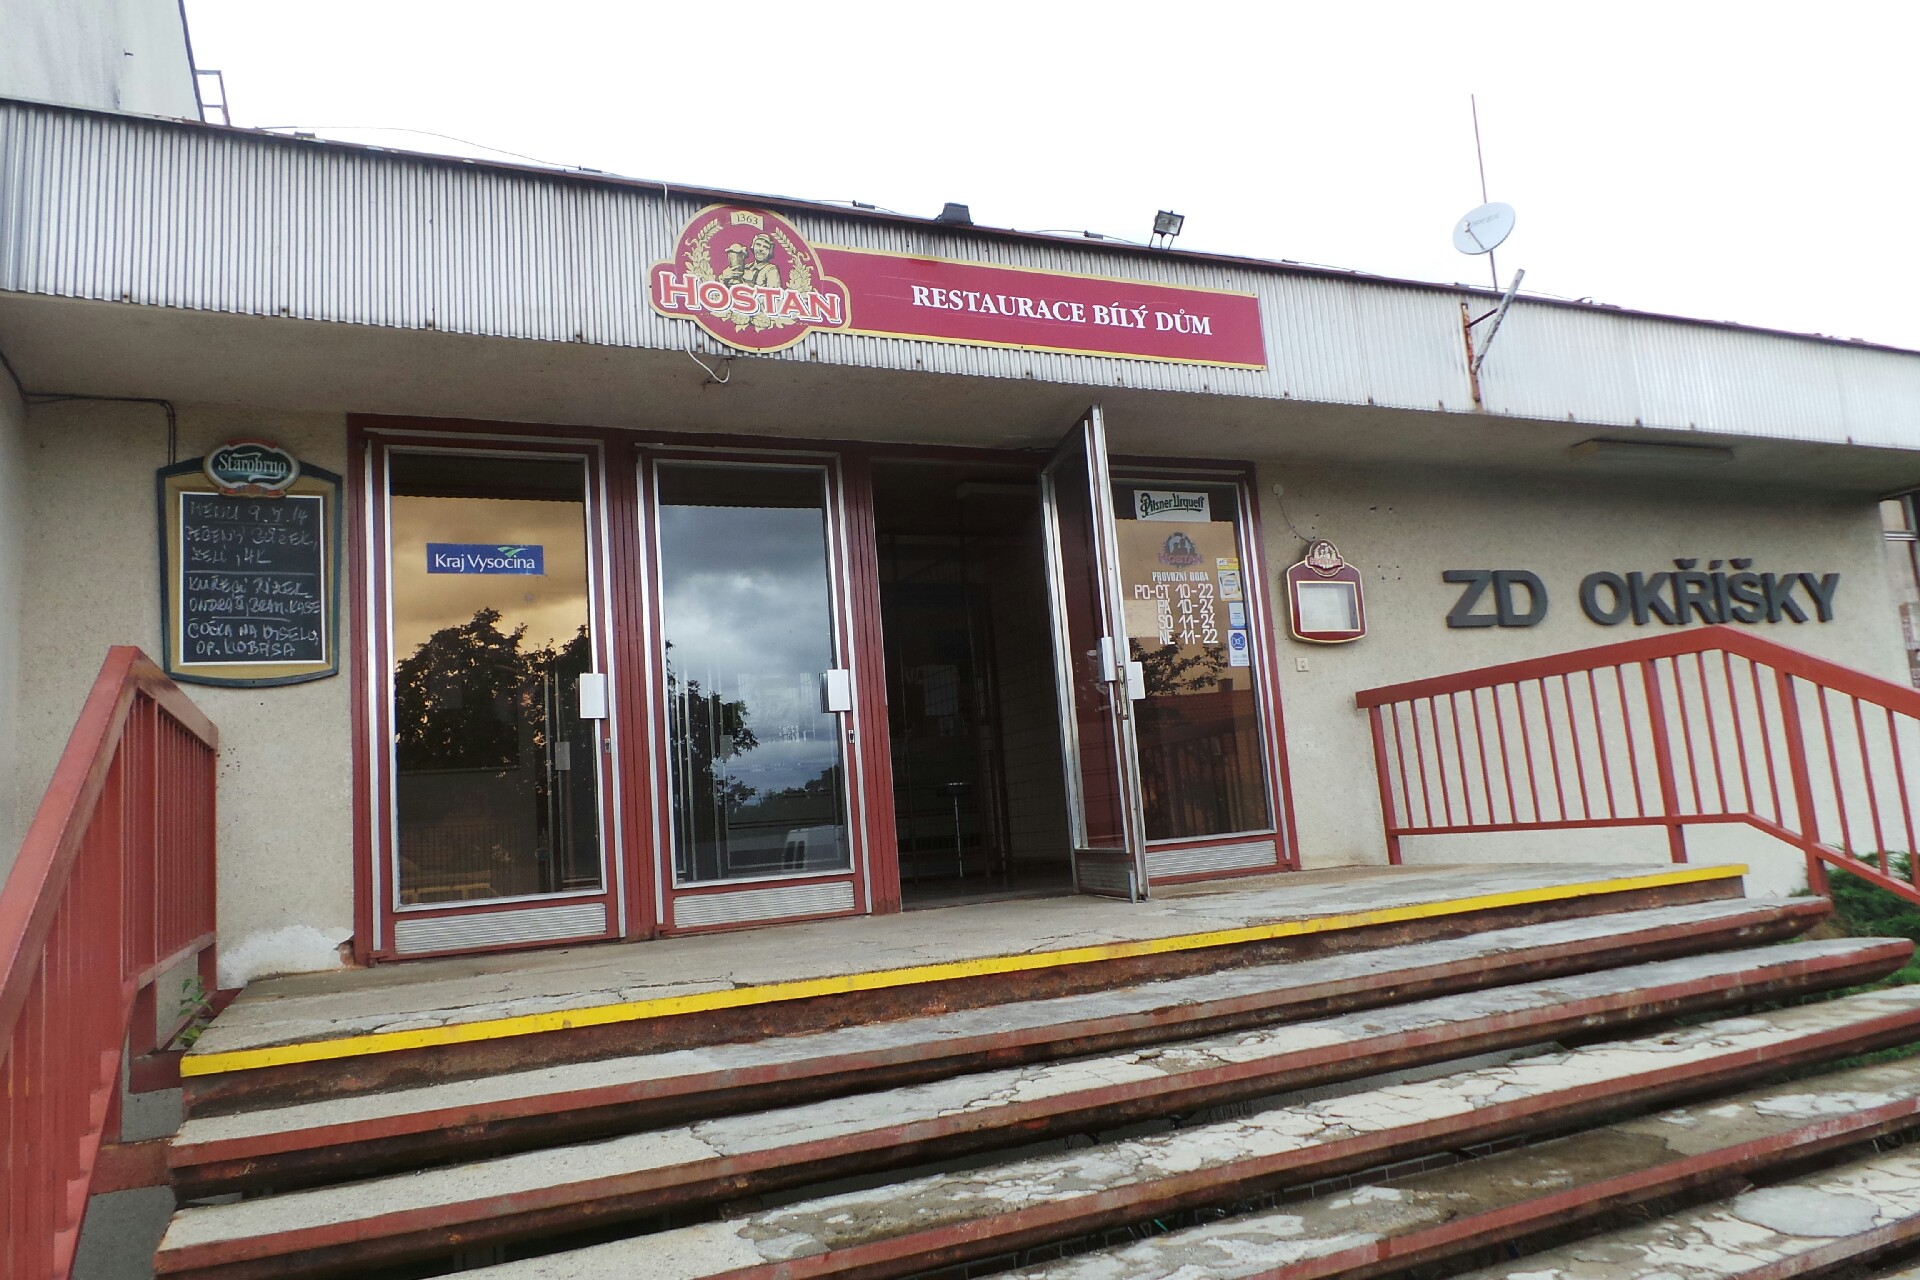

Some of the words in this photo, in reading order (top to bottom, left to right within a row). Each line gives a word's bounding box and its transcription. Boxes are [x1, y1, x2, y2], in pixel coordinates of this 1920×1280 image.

[736, 213, 759, 225] 1363
[659, 271, 842, 323] HOSTAN
[911, 285, 1086, 323] RESTAURACE
[1092, 302, 1148, 329] BÍLÝ
[1154, 308, 1212, 335] DŮM
[218, 452, 287, 481] Starobrno
[1140, 492, 1173, 518] Pilsner
[1172, 493, 1205, 512] Urquell
[435, 554, 465, 572] Kraj
[1190, 571, 1209, 582] DOBA
[1175, 583, 1215, 599] 10-22
[1442, 569, 1549, 628] ZD
[1579, 558, 1840, 626] OKŘÍŠKY
[1177, 598, 1214, 614] 10-24
[1158, 614, 1174, 629] SO
[1178, 613, 1216, 630] 11-24
[240, 623, 257, 638] NA
[1159, 629, 1176, 645] NE
[1180, 628, 1219, 645] 11-22
[196, 641, 221, 655] OP.
